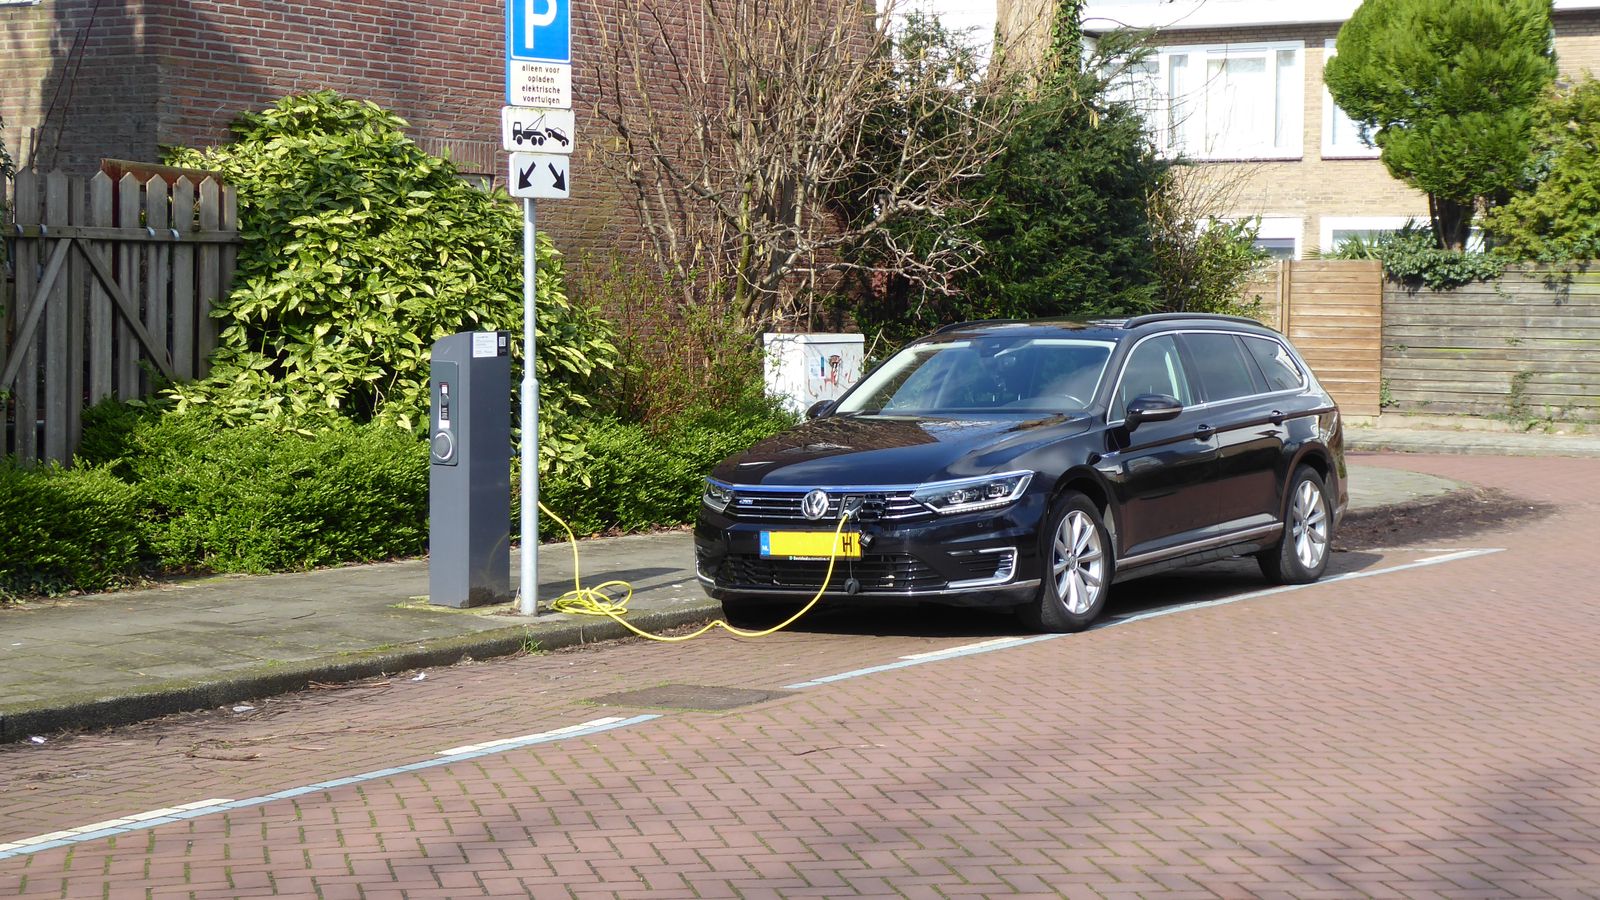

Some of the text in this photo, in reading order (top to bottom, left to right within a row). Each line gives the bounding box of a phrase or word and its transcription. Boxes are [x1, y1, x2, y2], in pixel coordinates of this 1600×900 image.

[525, 0, 557, 49] P
[522, 64, 560, 74] alleen voor
[528, 75, 555, 84] opladen
[522, 84, 560, 94] elektrische
[523, 95, 560, 105] voertuigen
